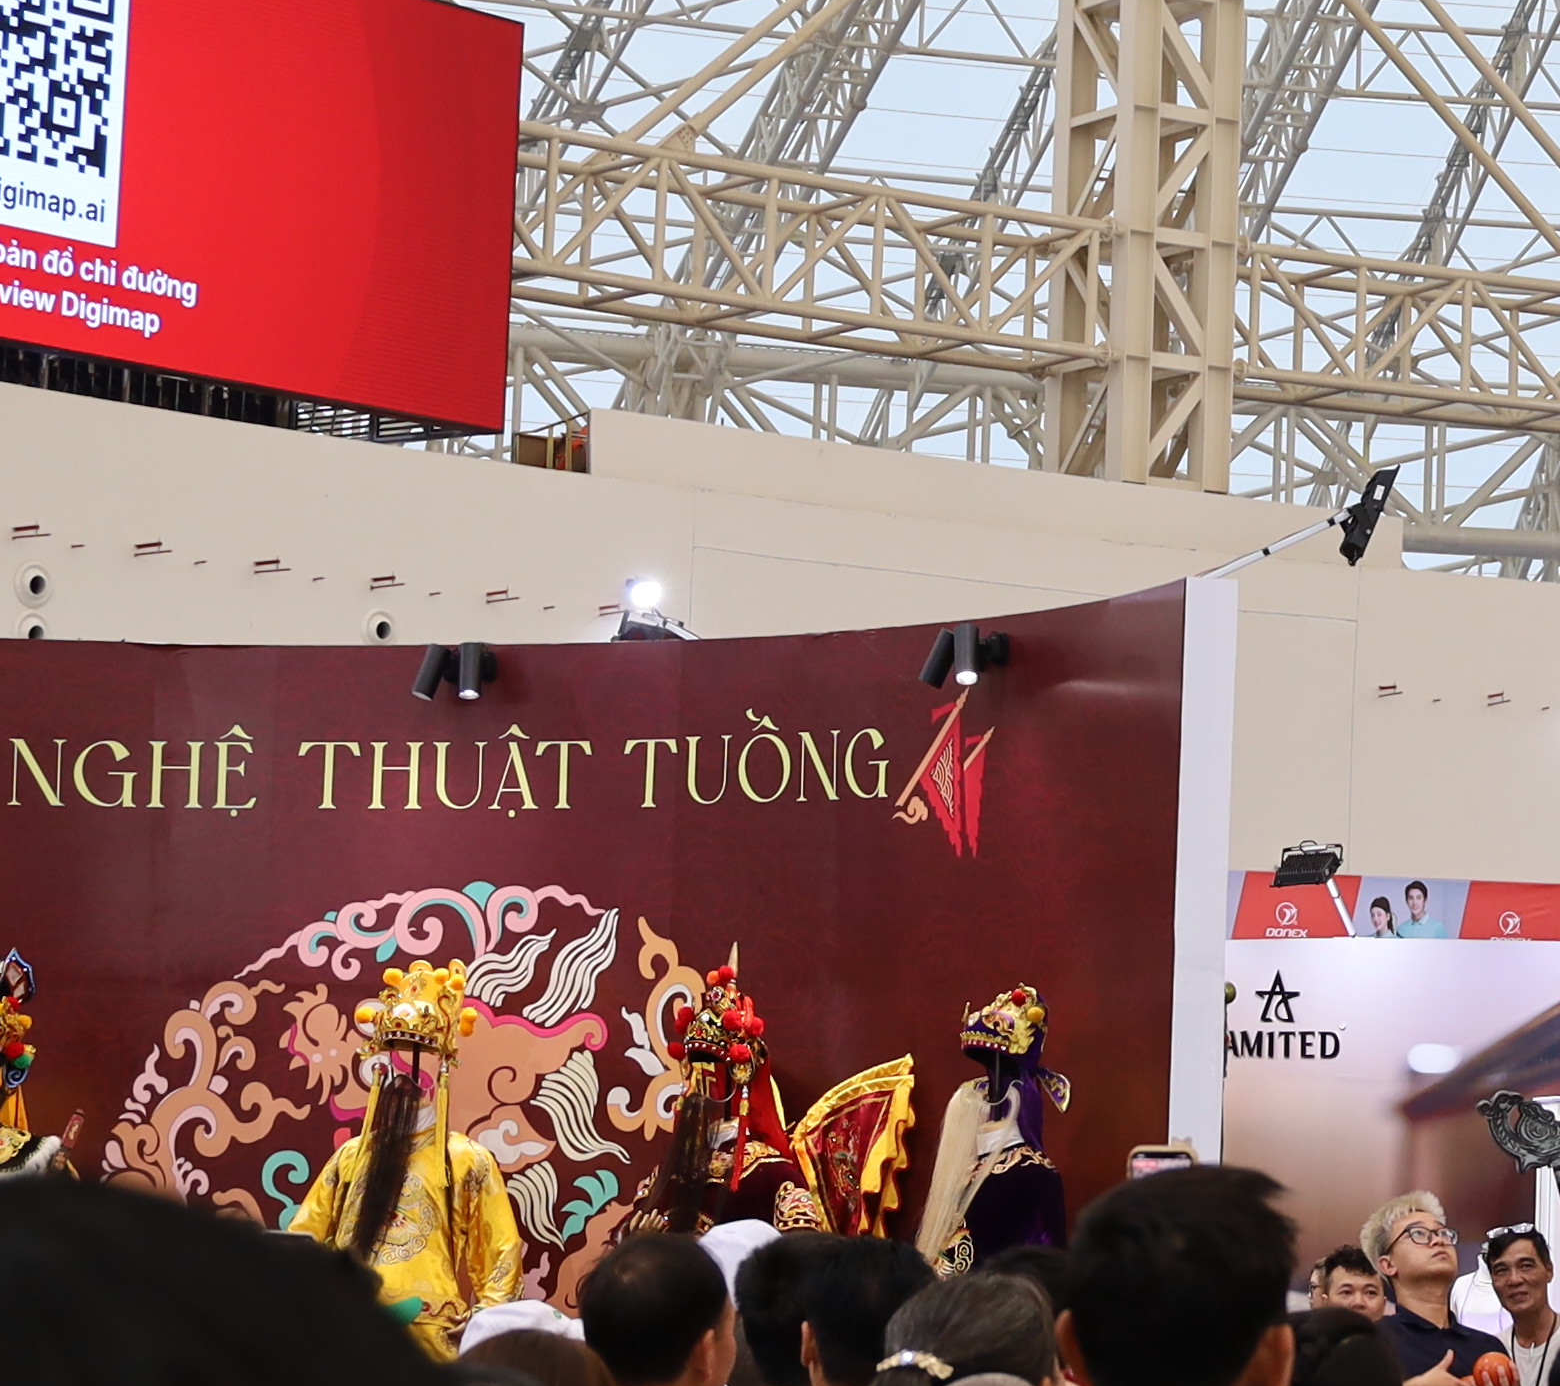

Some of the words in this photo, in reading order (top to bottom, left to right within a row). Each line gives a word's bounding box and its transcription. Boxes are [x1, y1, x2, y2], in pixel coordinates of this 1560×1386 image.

[42, 246, 74, 277] đồ
[79, 258, 117, 286] chỉ
[121, 265, 198, 308] đường
[61, 290, 161, 338] Digimap
[7, 723, 257, 818] NGHỆ
[298, 723, 592, 818] THUẬT
[624, 708, 890, 809] TUỒNG
[1265, 927, 1308, 938] DONEX
